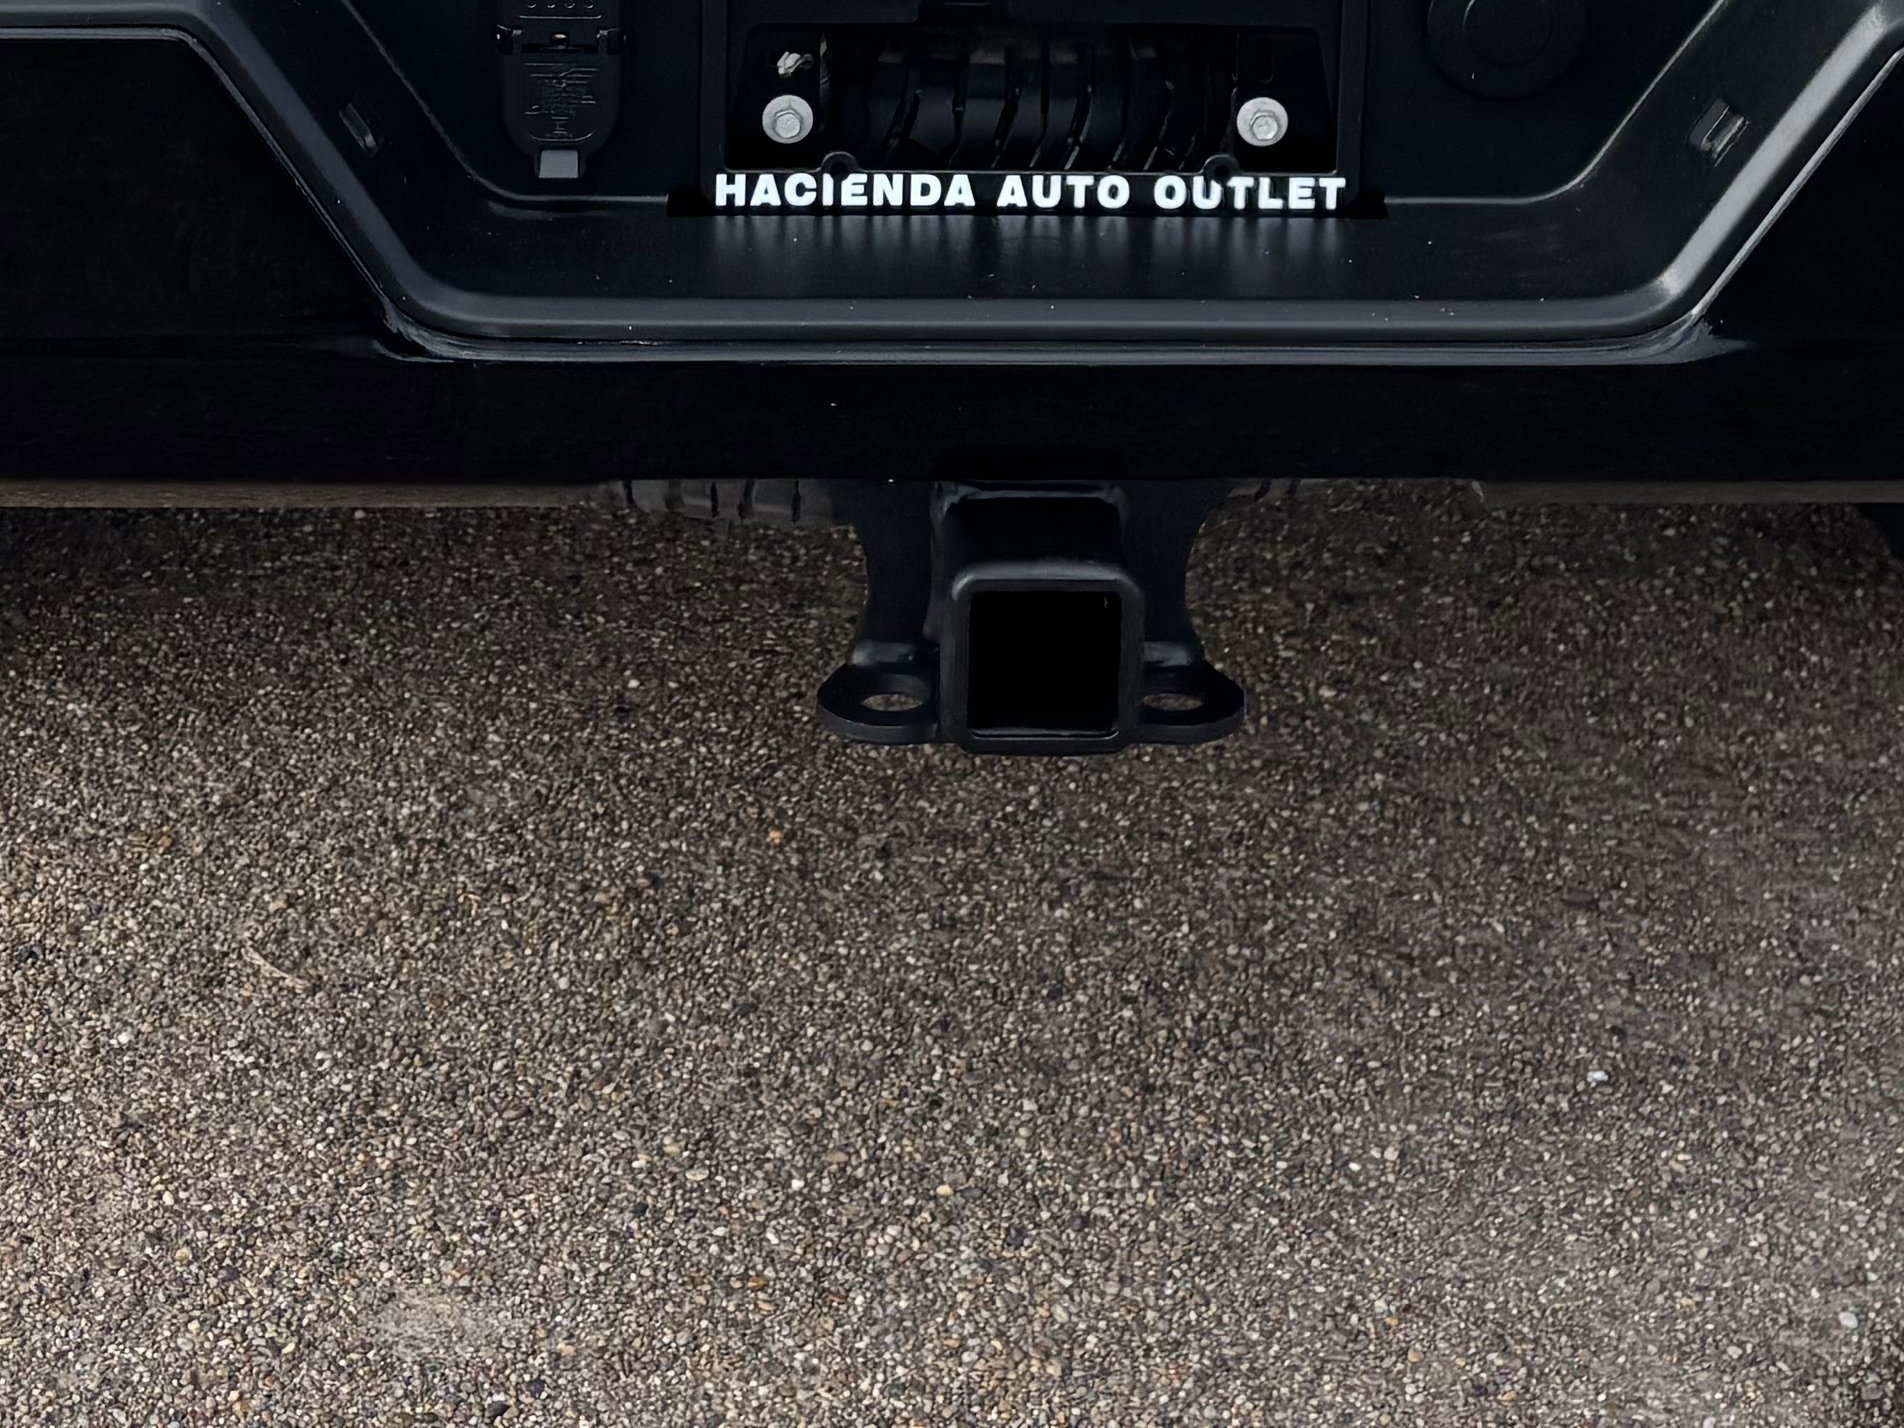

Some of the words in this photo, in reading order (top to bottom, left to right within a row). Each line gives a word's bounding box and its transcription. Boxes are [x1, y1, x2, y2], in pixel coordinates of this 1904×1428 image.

[715, 172, 976, 207] HACIENDA
[996, 173, 1130, 209] AUTO
[1153, 174, 1347, 211] OUTLET
